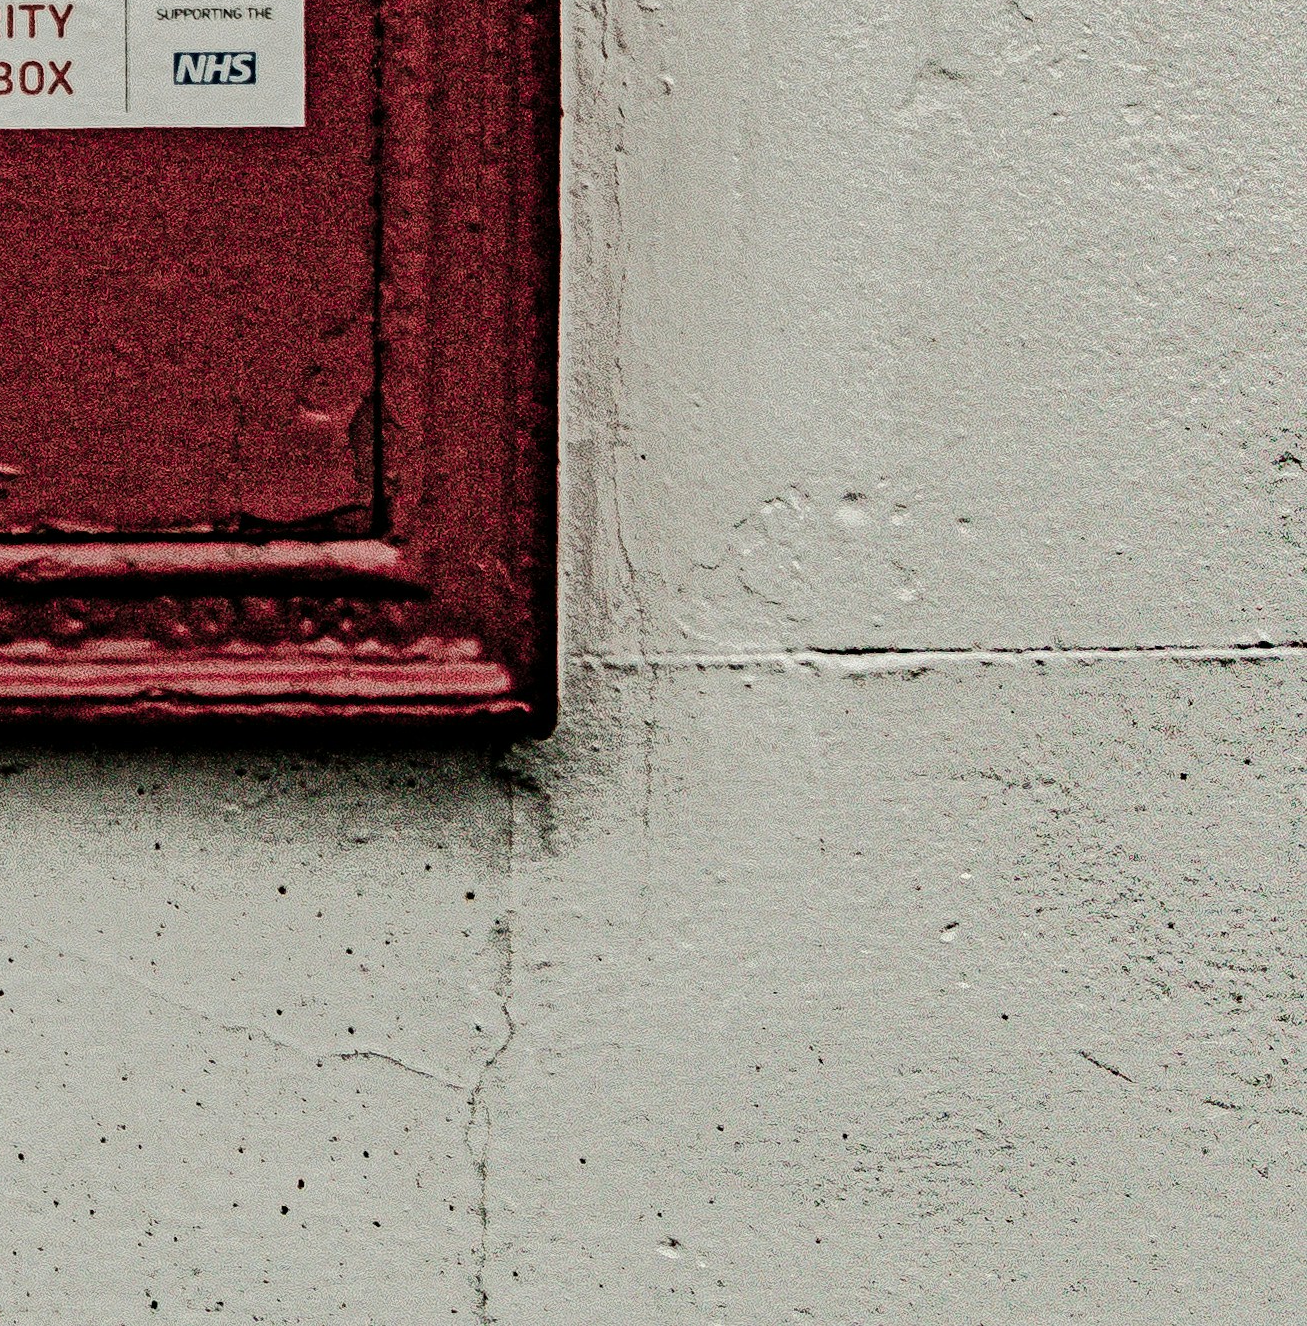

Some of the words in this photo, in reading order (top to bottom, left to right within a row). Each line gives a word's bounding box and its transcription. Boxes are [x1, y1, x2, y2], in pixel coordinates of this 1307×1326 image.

[156, 8, 243, 21] SUPPORTING
[248, 7, 273, 20] THE
[175, 54, 253, 83] NHS
